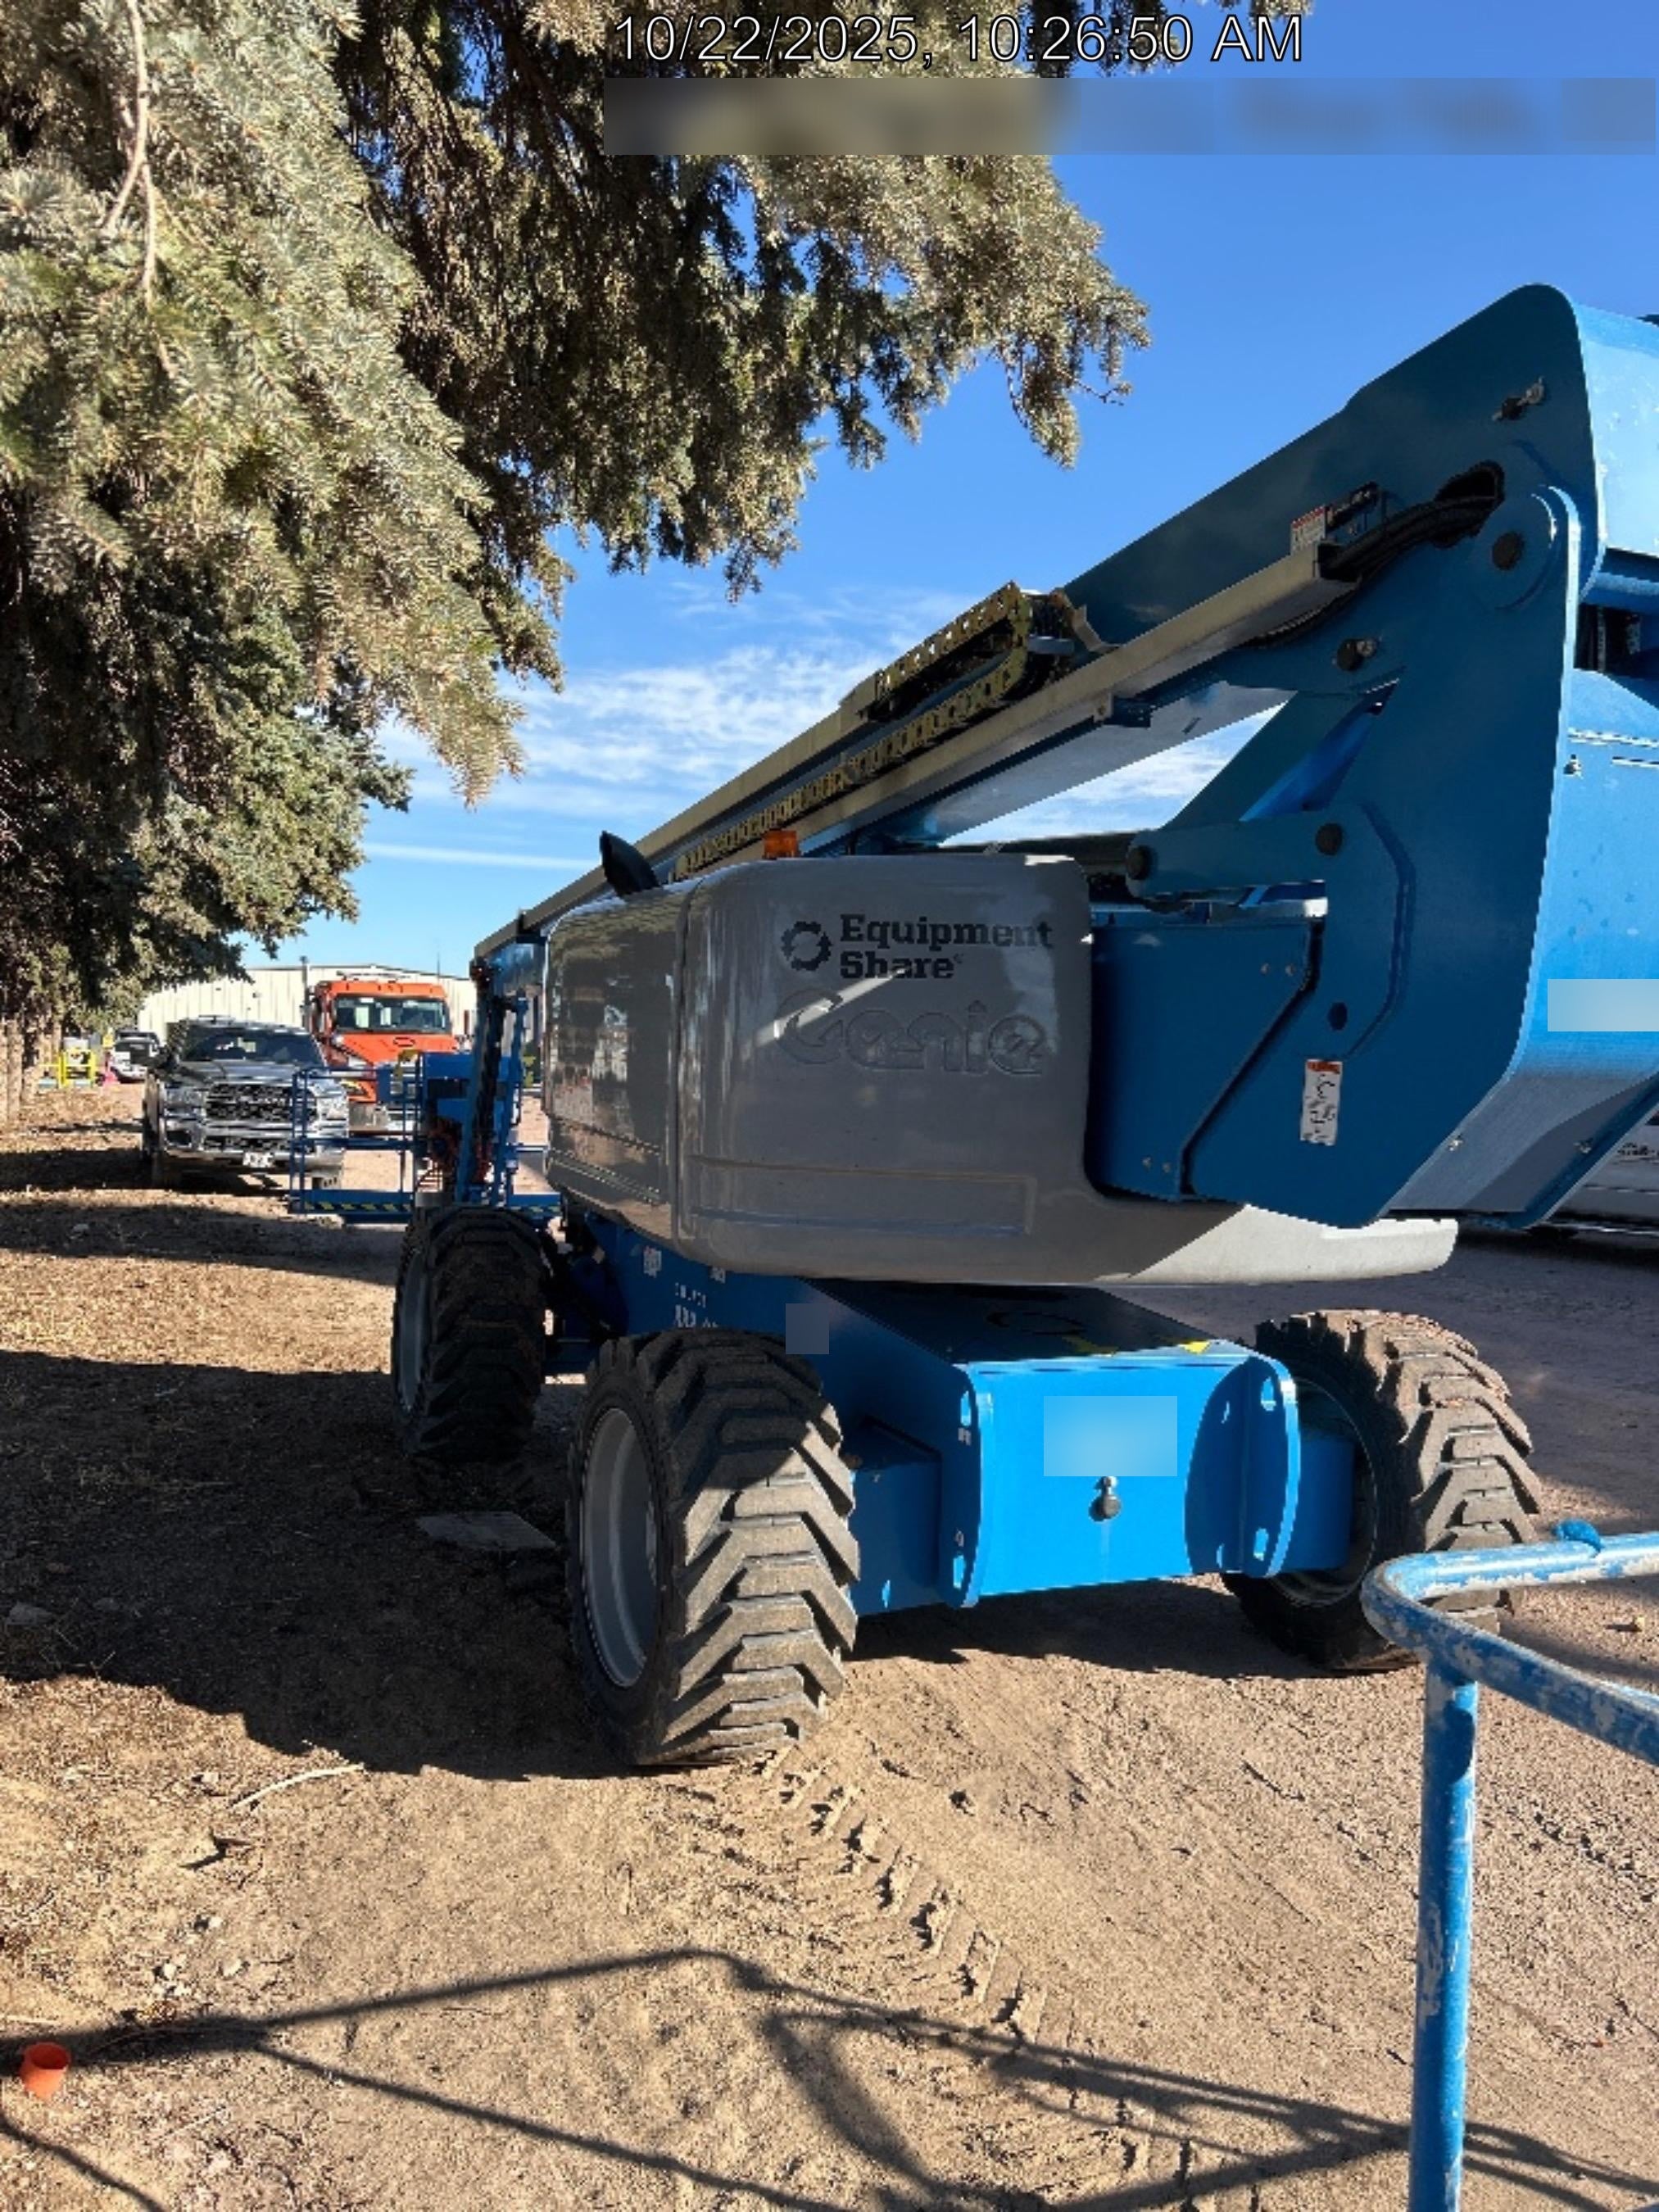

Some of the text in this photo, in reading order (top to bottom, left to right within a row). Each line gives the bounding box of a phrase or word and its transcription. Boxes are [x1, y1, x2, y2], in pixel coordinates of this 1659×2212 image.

[840, 913, 1054, 950] Equipment
[840, 951, 954, 980] Share
[776, 988, 1047, 1076] Genie
